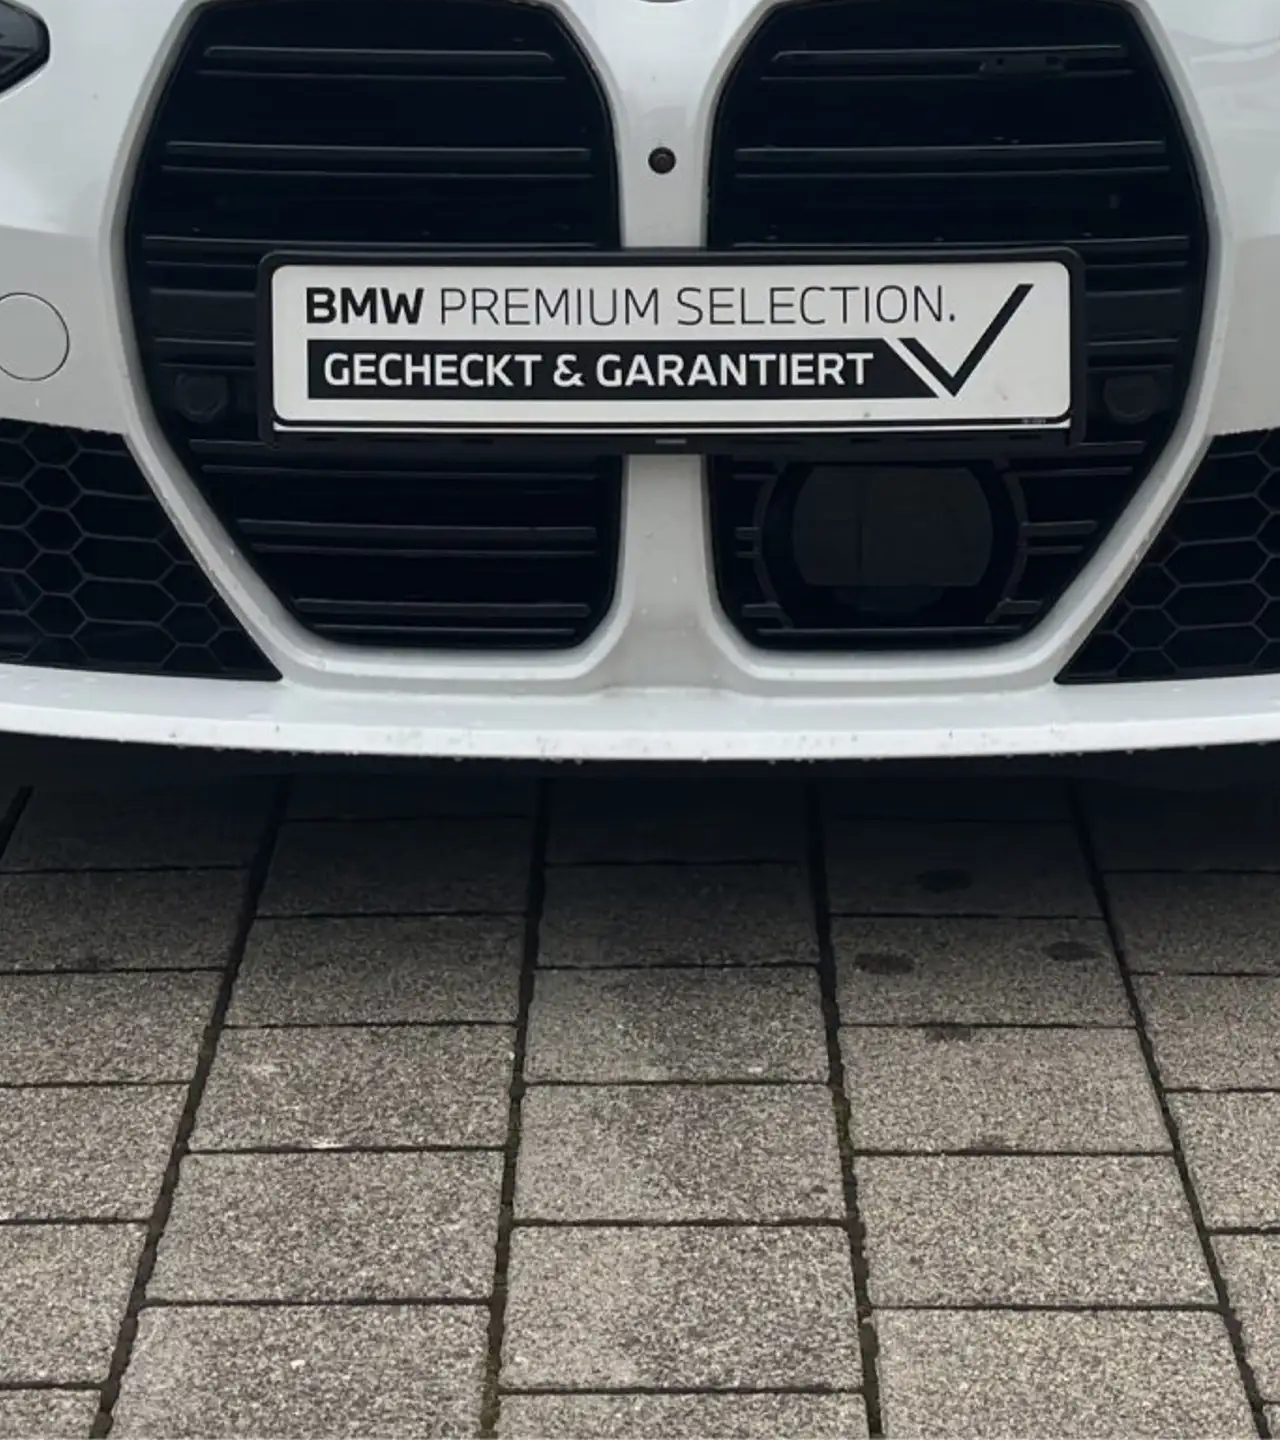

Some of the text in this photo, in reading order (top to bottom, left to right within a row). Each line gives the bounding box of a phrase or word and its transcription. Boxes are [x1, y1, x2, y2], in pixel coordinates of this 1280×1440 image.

[306, 284, 956, 326] BMW PREMIUM SELECTION.
[324, 352, 875, 388] GECHECKT & GARANTIERT
